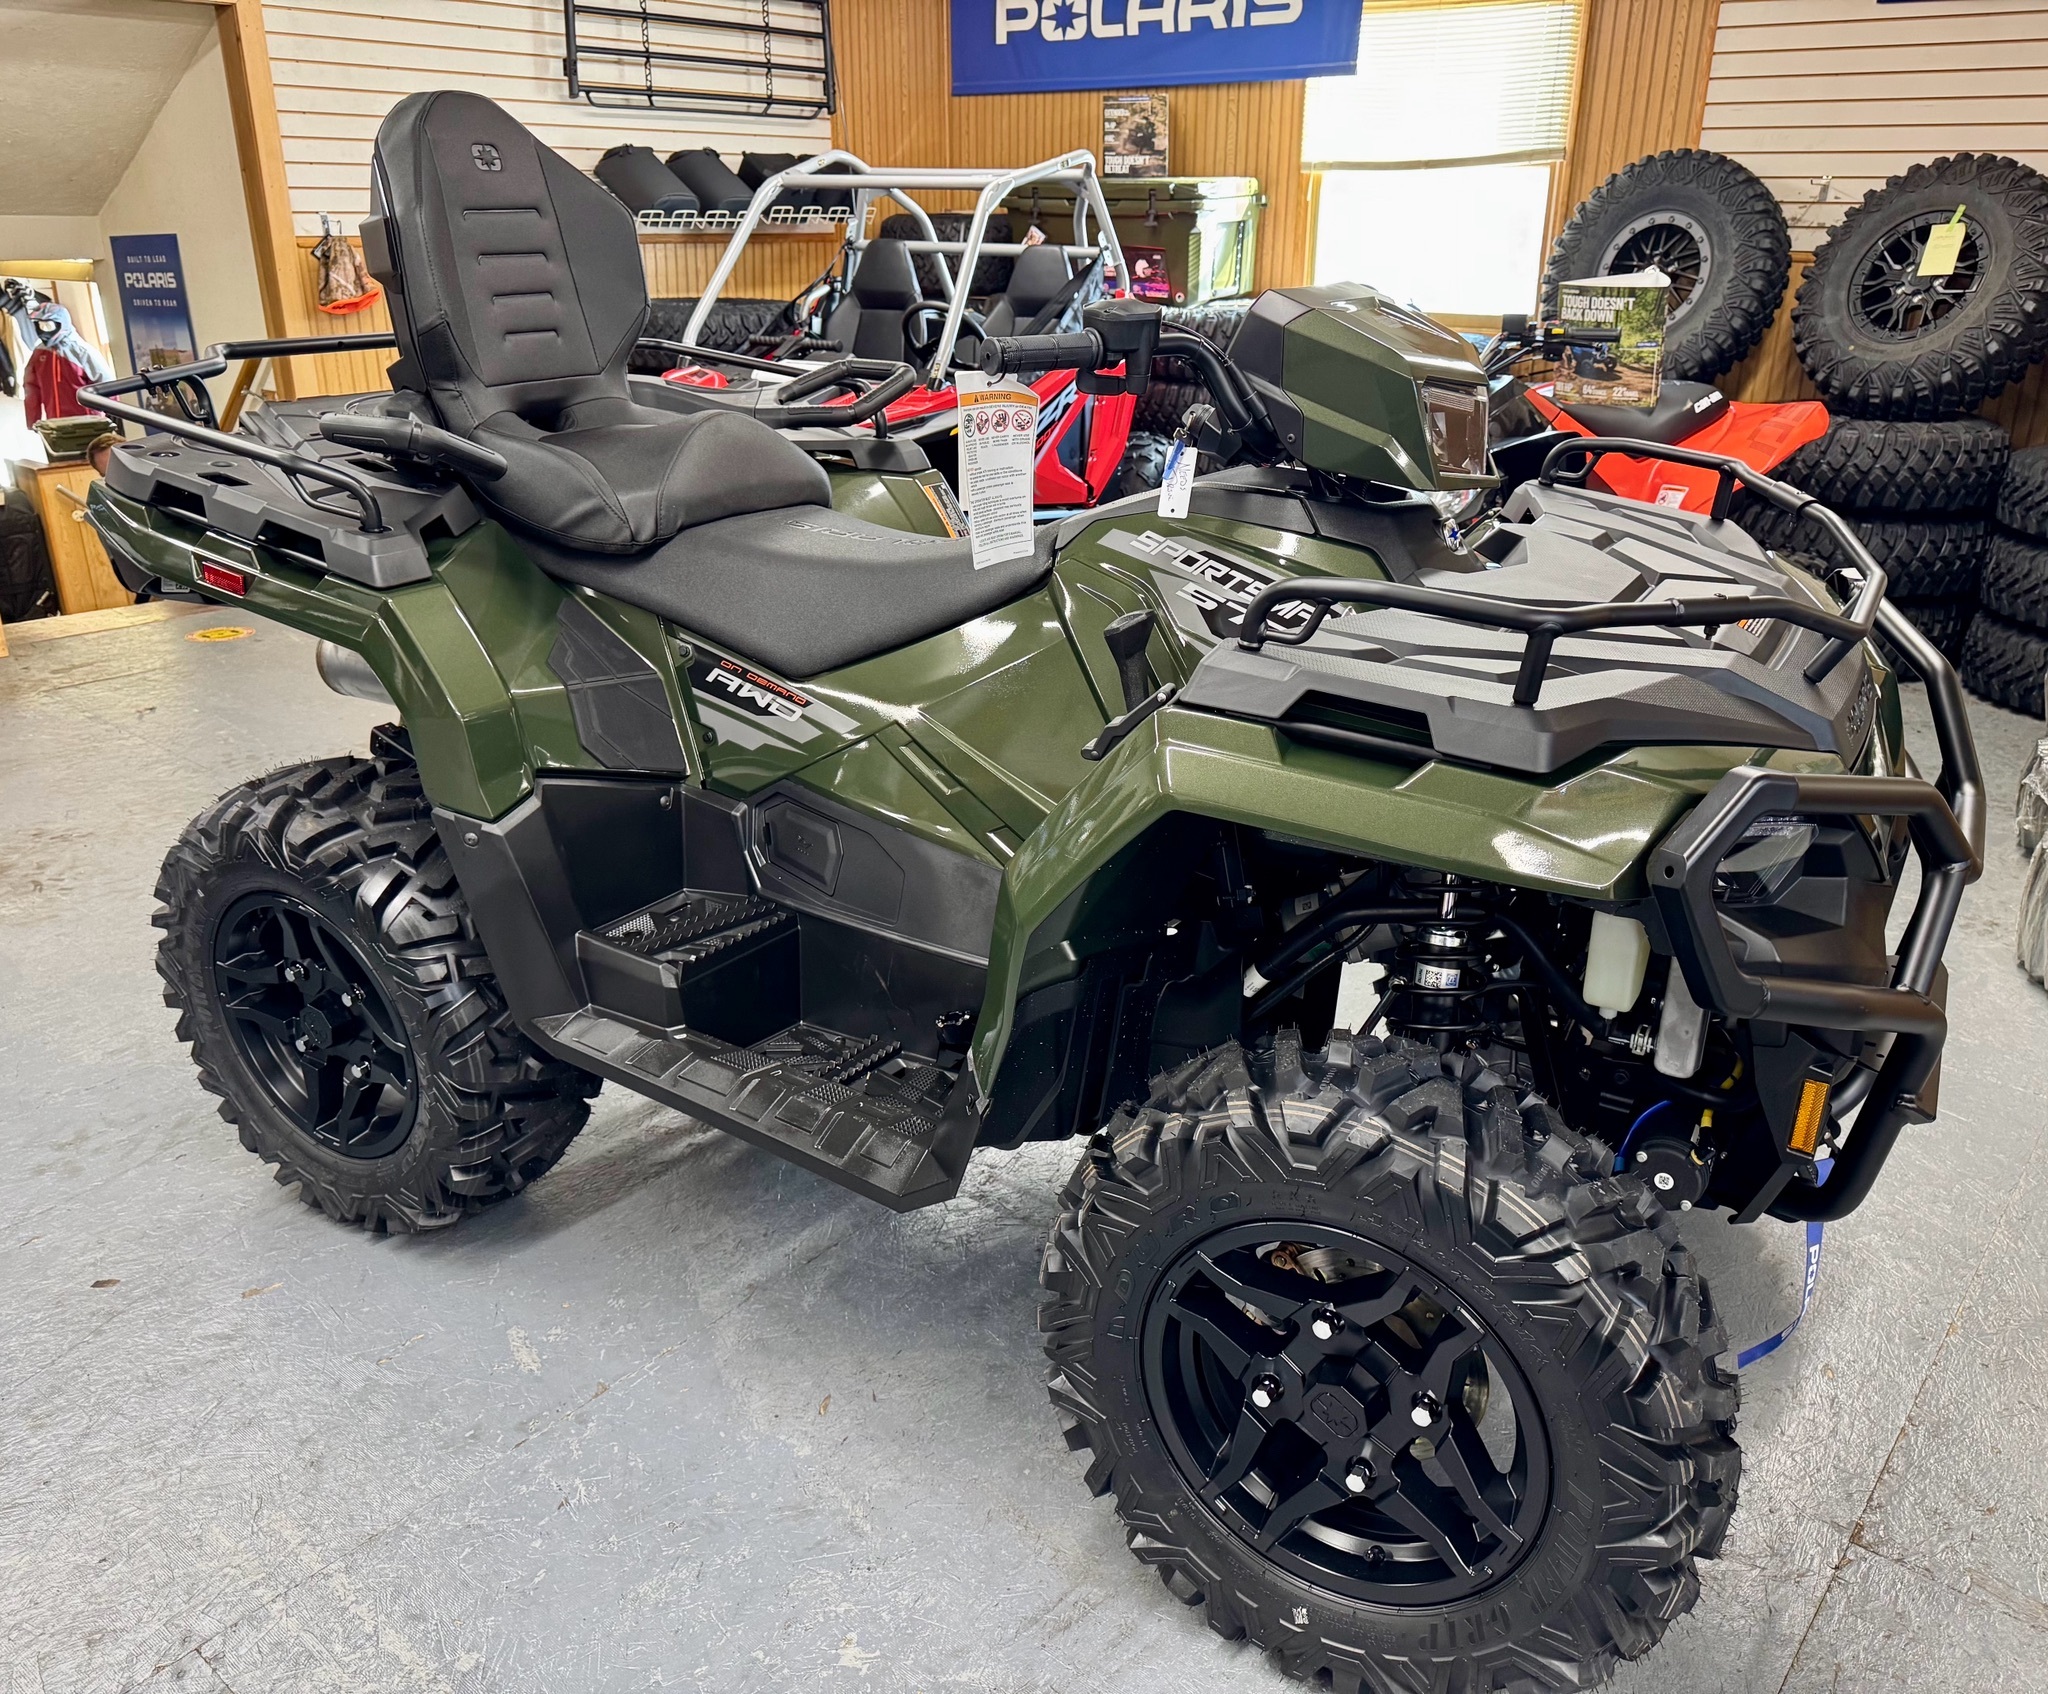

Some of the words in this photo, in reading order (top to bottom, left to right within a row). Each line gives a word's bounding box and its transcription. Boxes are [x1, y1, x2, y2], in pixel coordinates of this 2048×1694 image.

[995, 0, 1304, 45] POLARIS
[144, 255, 151, 263] TO
[124, 272, 177, 288] POLARIS
[1562, 295, 1590, 309] TOUGH
[1591, 297, 1635, 311] DOESN'T
[1561, 308, 1583, 320] BACK
[1584, 309, 1614, 323] DOWN
[980, 393, 1011, 401] WARNING
[720, 660, 743, 674] ON
[746, 672, 807, 705] DEMAND
[705, 667, 803, 722] AWD
